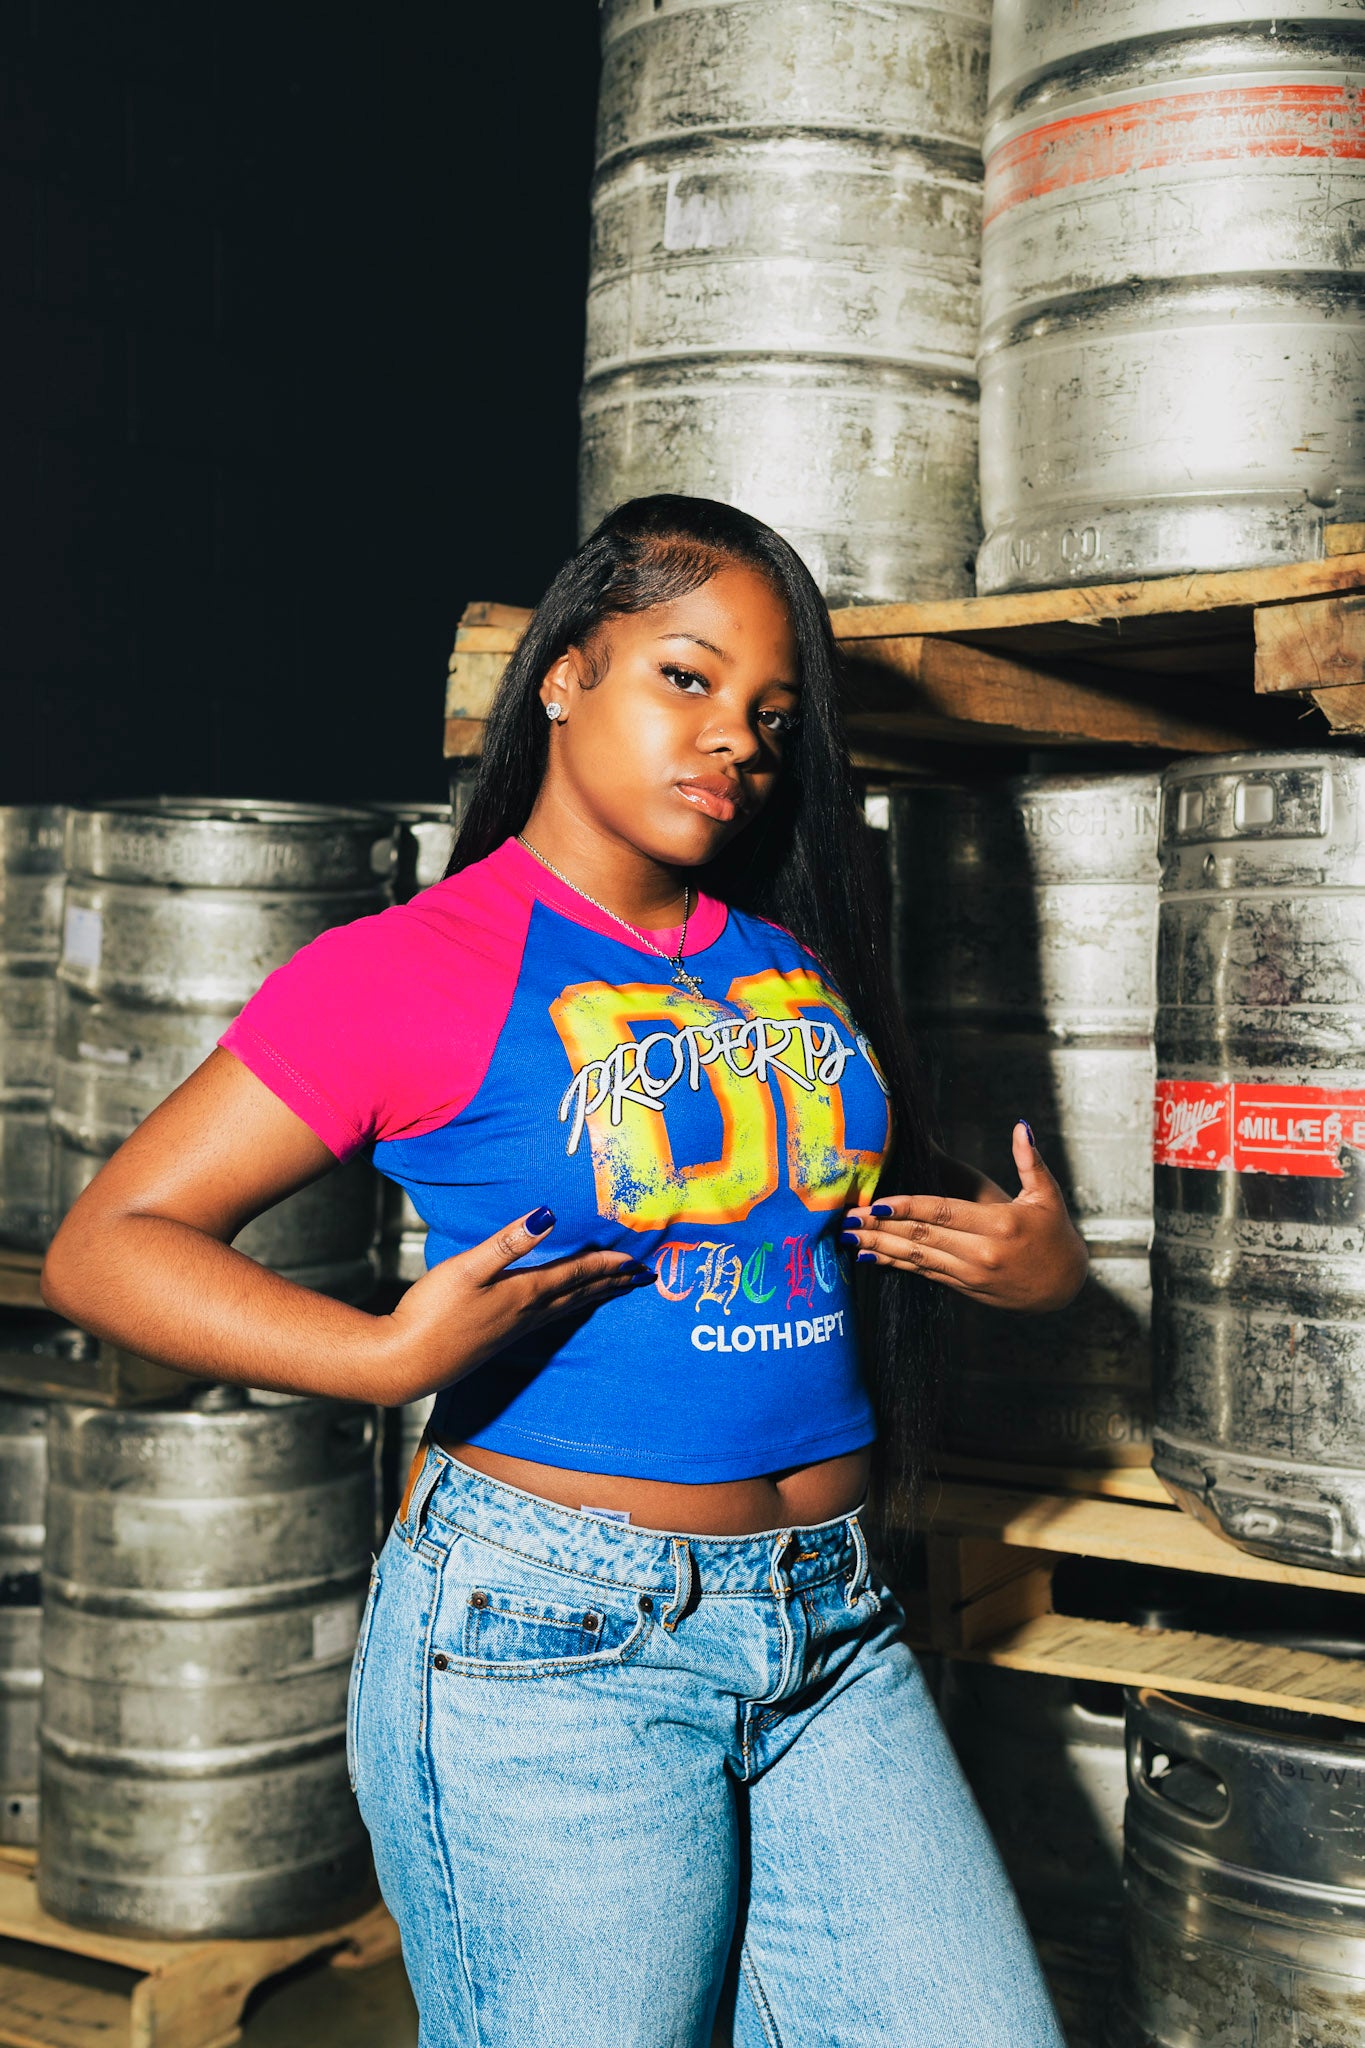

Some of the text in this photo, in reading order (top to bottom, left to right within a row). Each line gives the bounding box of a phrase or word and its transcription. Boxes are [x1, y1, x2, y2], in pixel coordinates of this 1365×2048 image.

[557, 1015, 856, 1157] PROPERTY
[1162, 1098, 1226, 1145] Miller
[1242, 1114, 1343, 1143] MILLER
[691, 1310, 844, 1352] CLOTH DEPT
